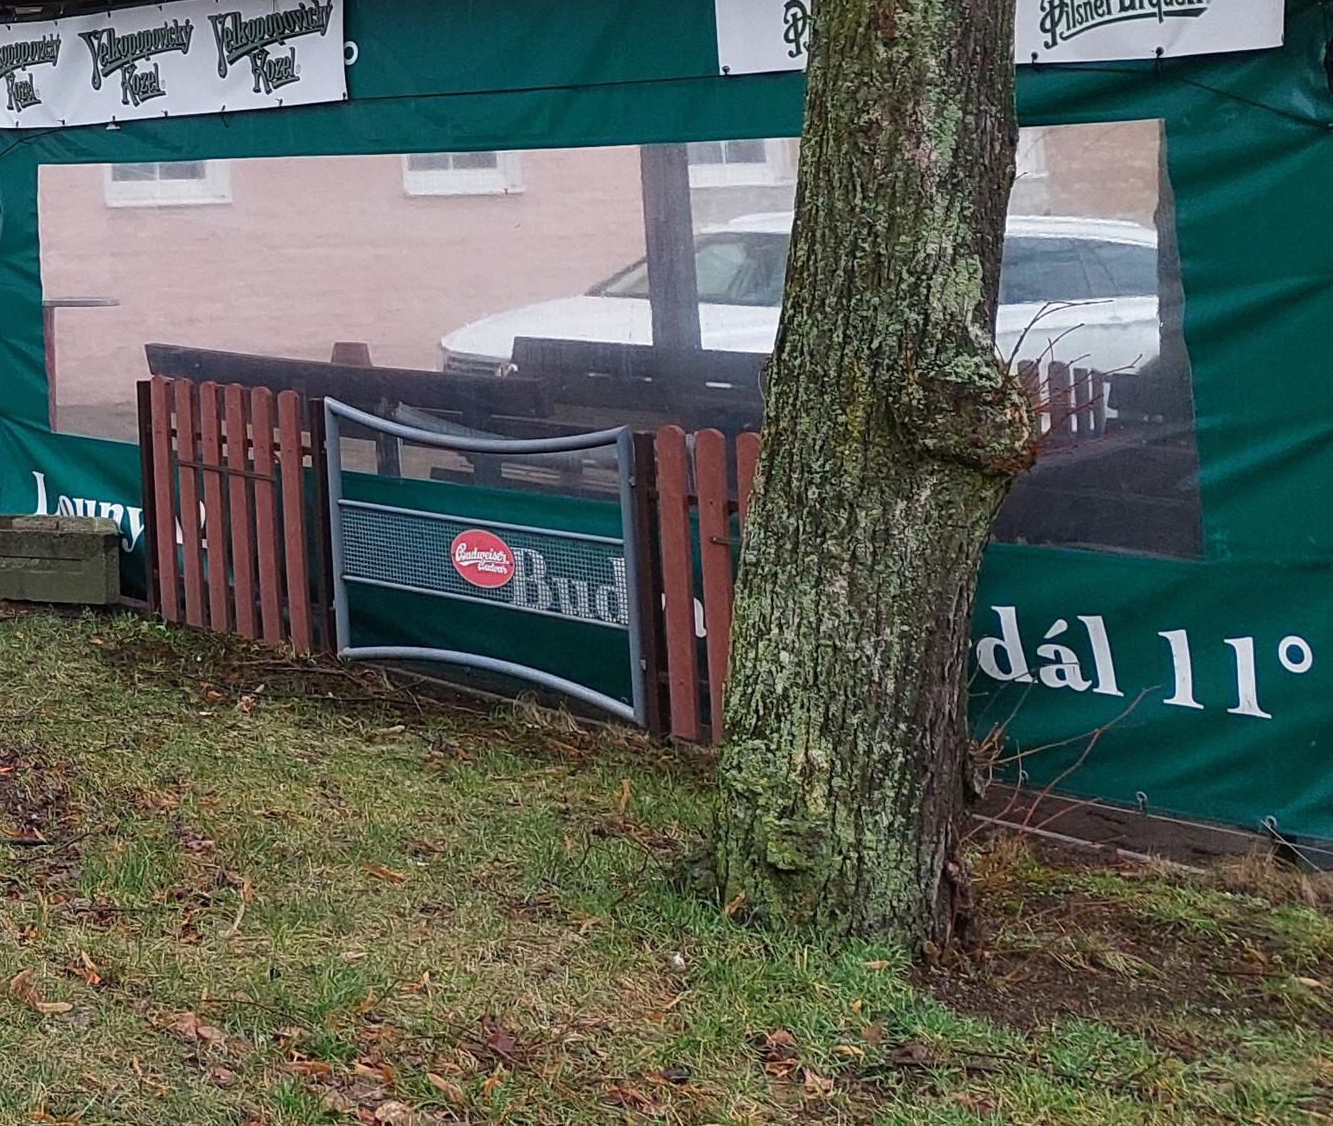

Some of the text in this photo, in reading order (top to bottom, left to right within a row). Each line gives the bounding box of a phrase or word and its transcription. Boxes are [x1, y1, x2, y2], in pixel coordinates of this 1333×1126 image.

[78, 19, 194, 90] Velkopopovický
[248, 46, 300, 95] Kozel
[6, 72, 42, 113] Kozel
[119, 61, 166, 107] Kozel
[455, 542, 509, 565] Budweiser
